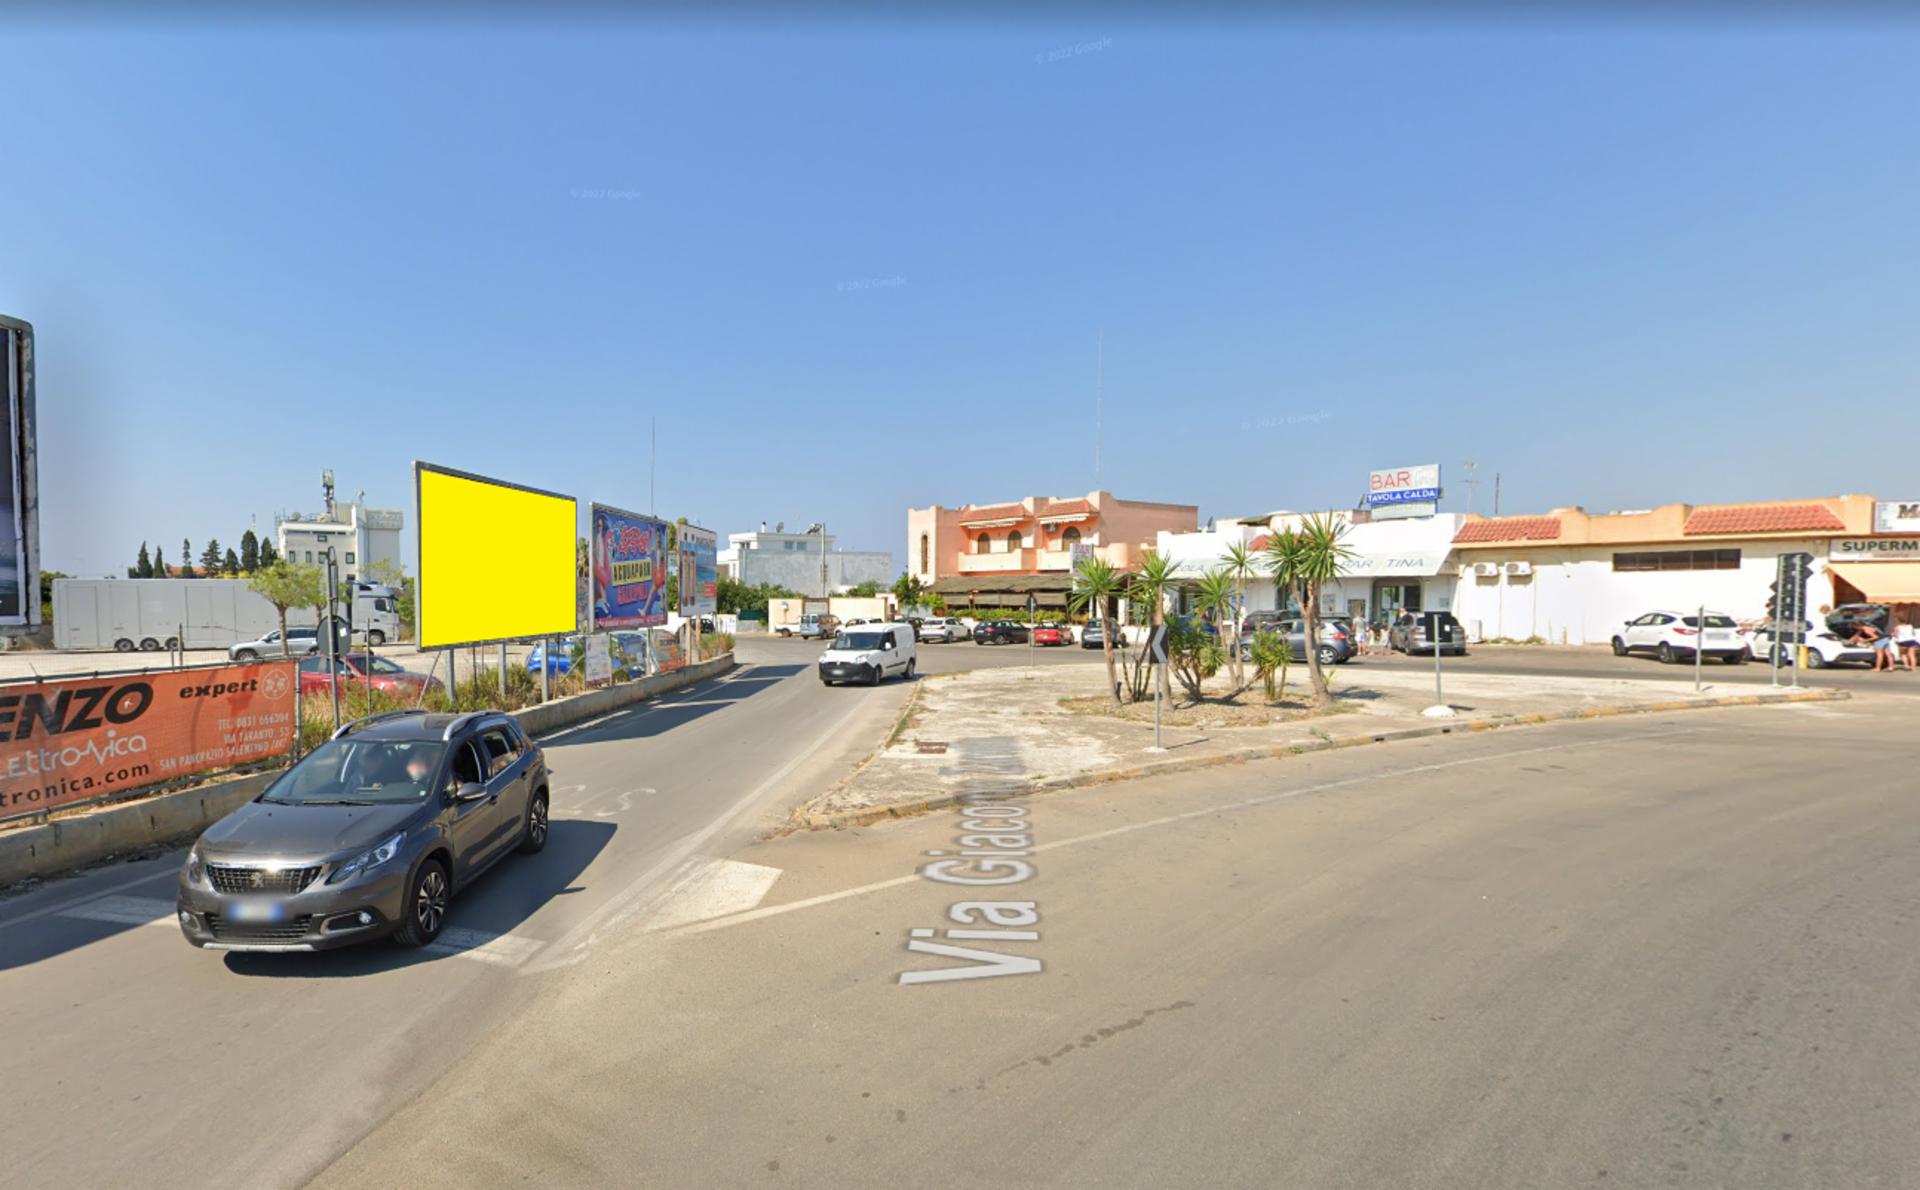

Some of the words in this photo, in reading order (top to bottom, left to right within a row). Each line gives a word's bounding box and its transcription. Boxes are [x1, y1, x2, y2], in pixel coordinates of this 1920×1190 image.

[1371, 471, 1411, 490] BAR
[1368, 492, 1402, 502] TAVOLA
[1403, 489, 1436, 499] CALDA
[1386, 558, 1425, 568] TINA
[179, 677, 258, 700] expert
[159, 757, 177, 769] SAN
[178, 749, 224, 767] PANCRAZIO
[226, 741, 269, 757] SALENTINO
